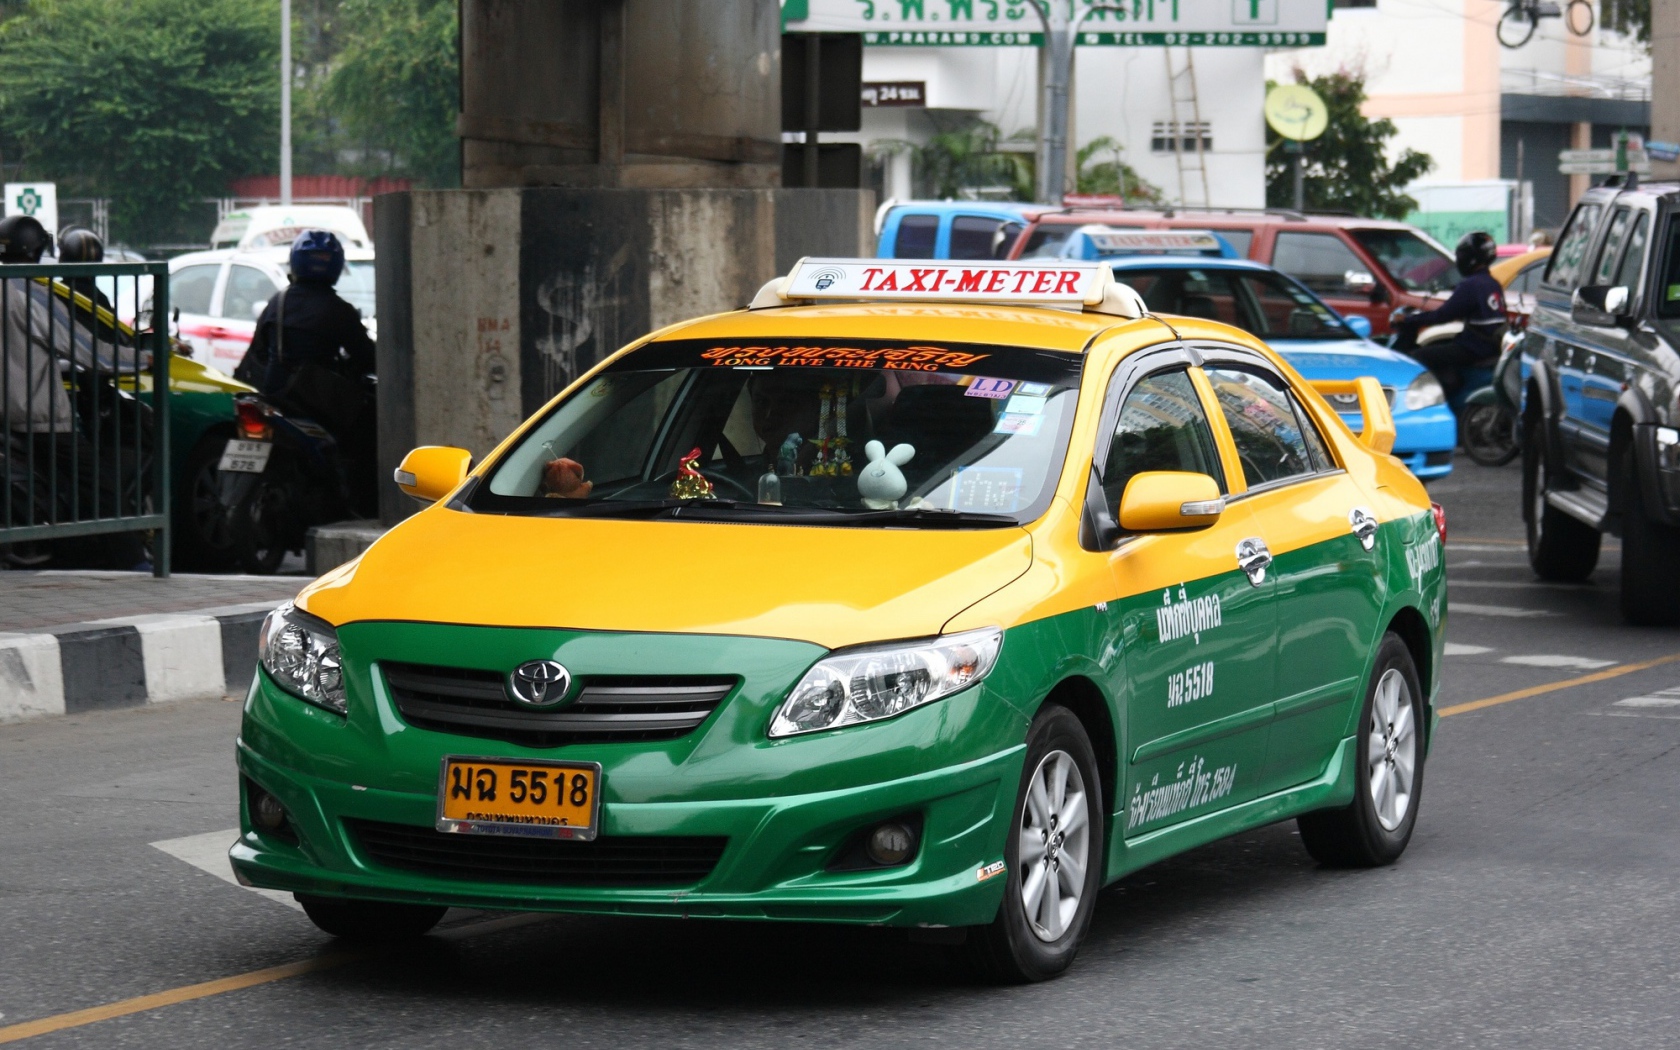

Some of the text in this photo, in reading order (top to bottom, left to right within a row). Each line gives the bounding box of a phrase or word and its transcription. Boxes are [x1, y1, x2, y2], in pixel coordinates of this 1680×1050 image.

[859, 268, 1082, 294] TAXI-METER
[701, 346, 992, 367] ทรงพระเจริญ
[712, 357, 939, 371] LONG LIVE THE KING
[1156, 582, 1221, 645] แท็กซี่บุคคล
[1185, 661, 1214, 703] 5518
[452, 766, 588, 807] มฉ 5518
